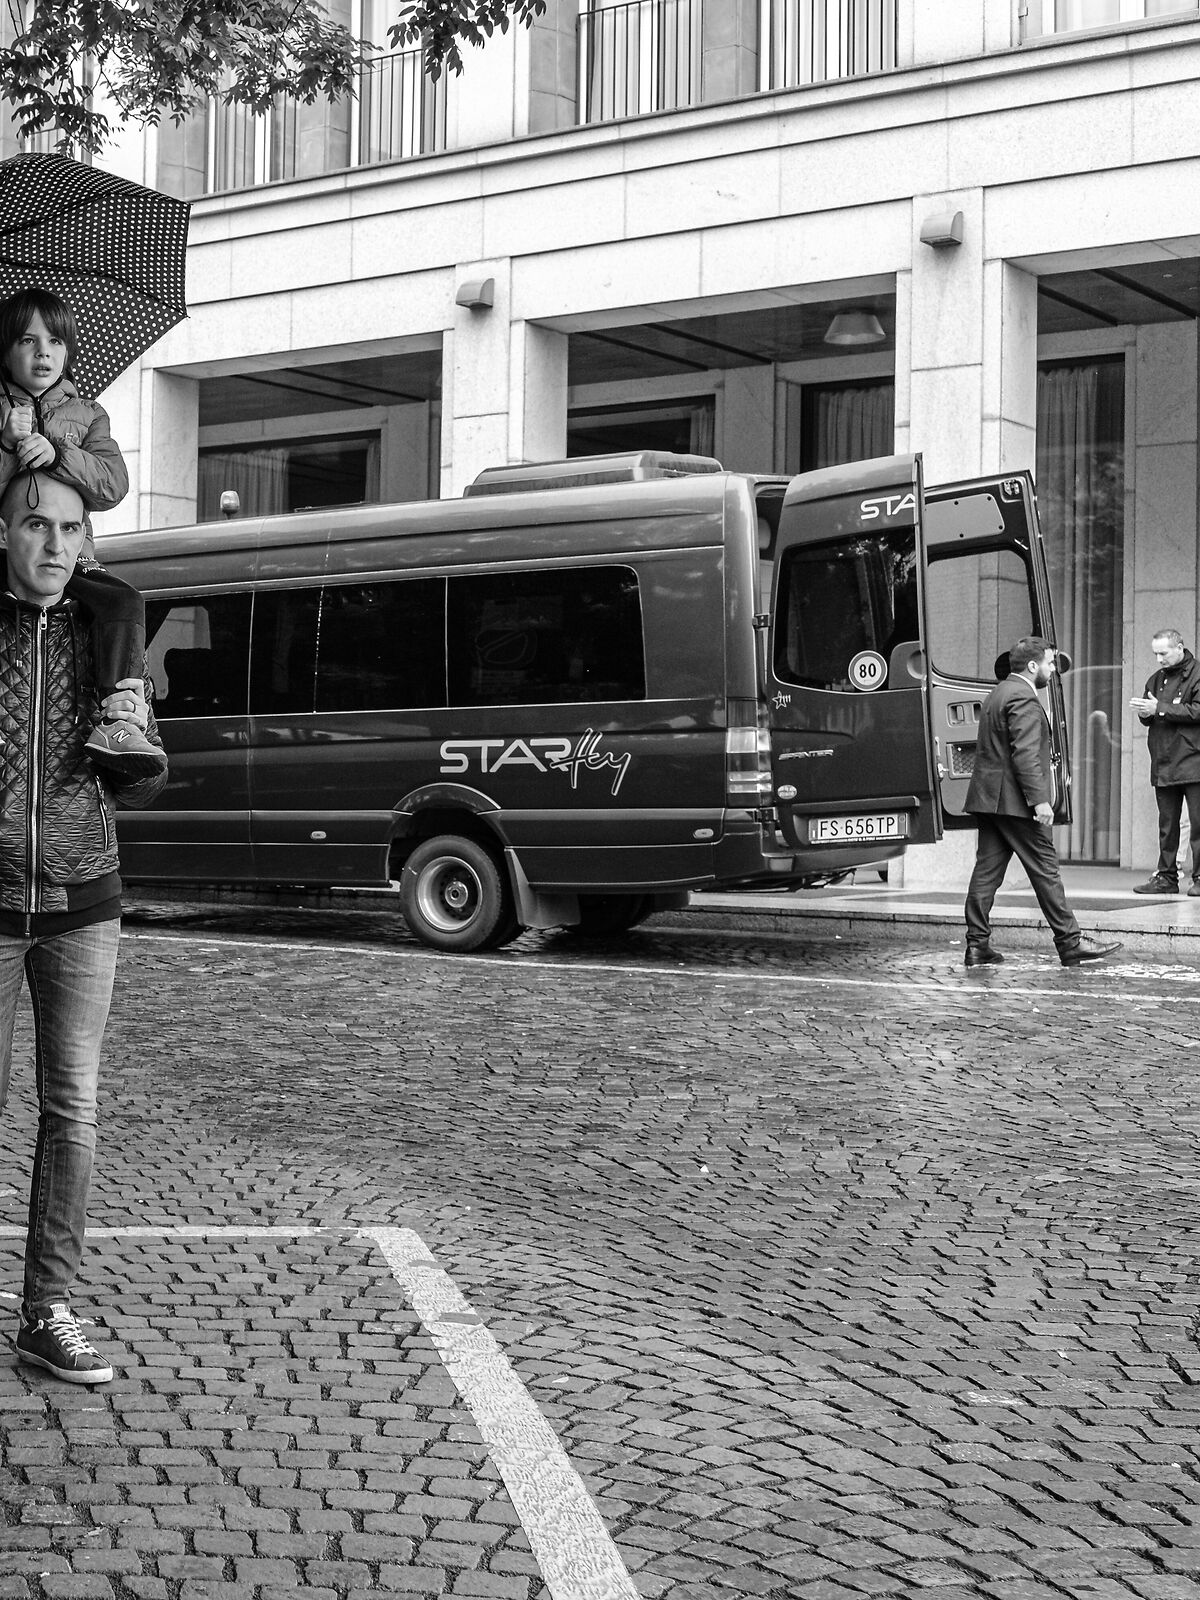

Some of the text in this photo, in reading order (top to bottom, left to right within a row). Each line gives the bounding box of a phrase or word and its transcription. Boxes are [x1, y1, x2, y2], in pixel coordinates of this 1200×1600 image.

[860, 493, 916, 520] STA
[859, 663, 877, 678] 80
[111, 729, 131, 743] N
[820, 816, 895, 837] FS 656TP
